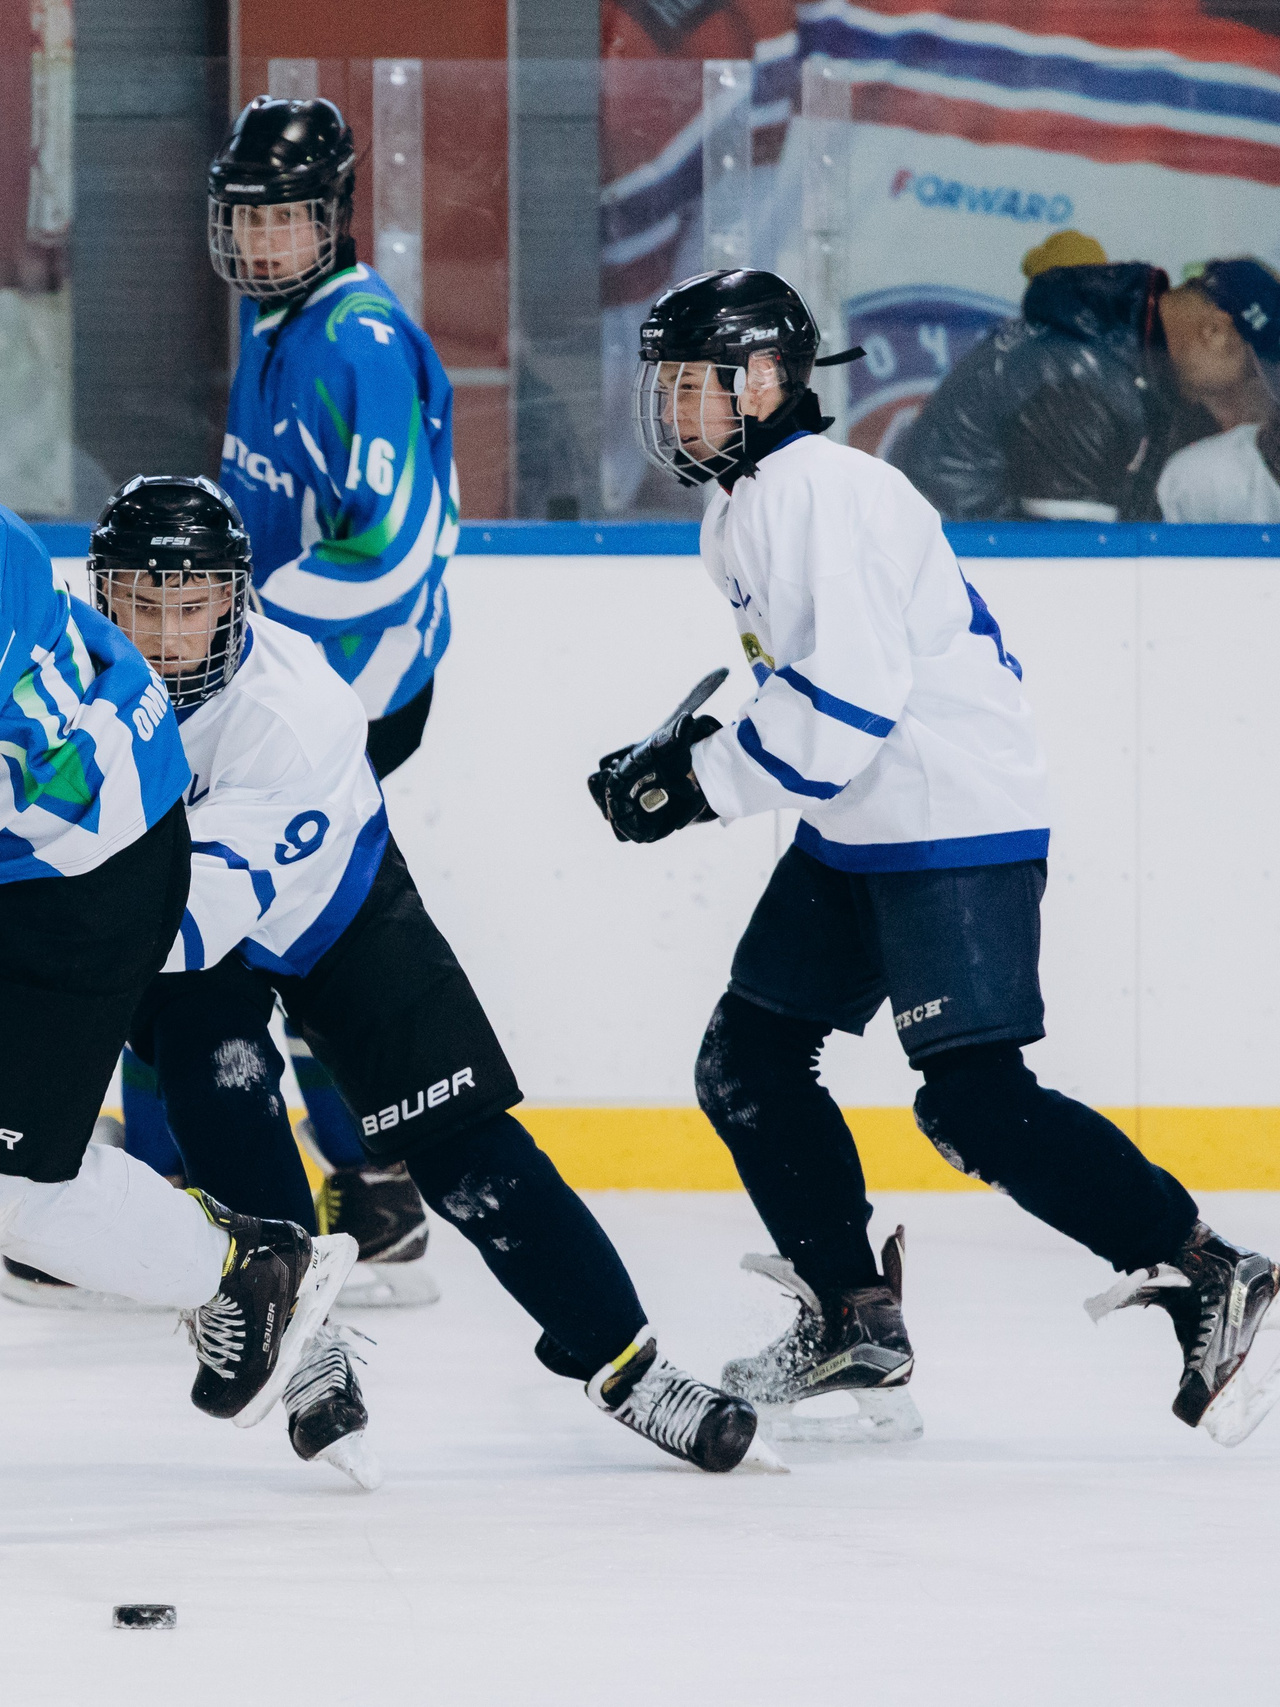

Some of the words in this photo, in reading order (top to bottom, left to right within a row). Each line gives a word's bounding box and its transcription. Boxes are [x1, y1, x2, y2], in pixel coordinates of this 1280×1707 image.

[150, 536, 191, 546] EFSI
[274, 809, 330, 866] 9
[894, 998, 943, 1031] TECH
